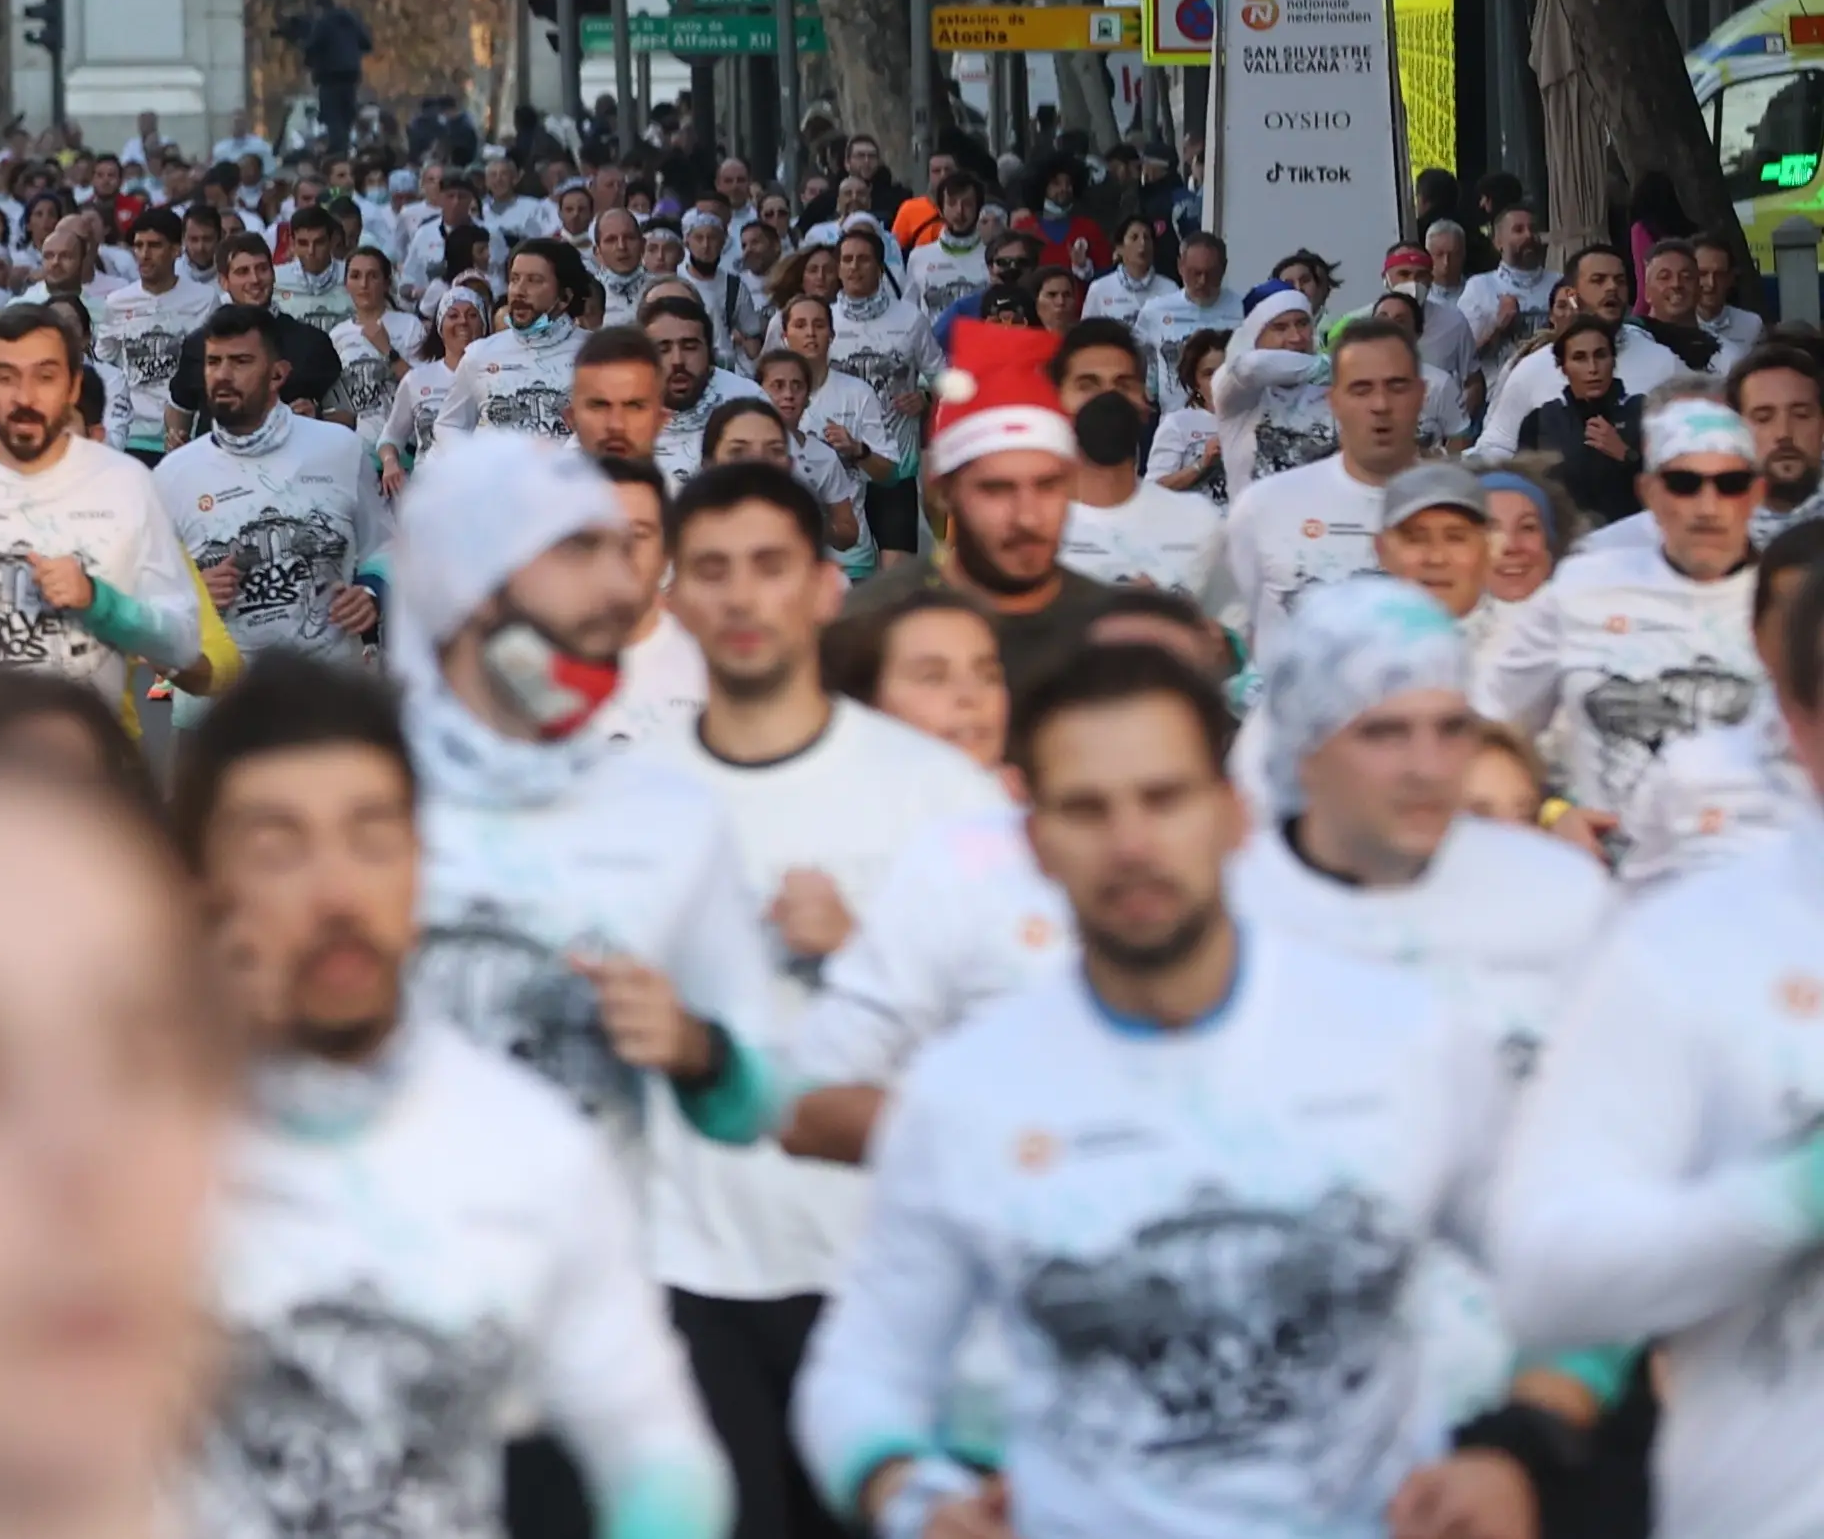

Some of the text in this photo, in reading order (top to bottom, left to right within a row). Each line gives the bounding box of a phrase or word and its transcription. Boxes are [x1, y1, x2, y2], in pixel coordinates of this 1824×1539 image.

[1286, 11, 1372, 24] nederlanden
[674, 30, 738, 48] Alfonso
[939, 26, 1009, 44] Atocha
[1243, 45, 1372, 60] SAN SILVESTRE
[1243, 59, 1372, 74] VALLECANA 21
[1264, 111, 1351, 130] OYSHO
[1287, 164, 1352, 183] TikTok
